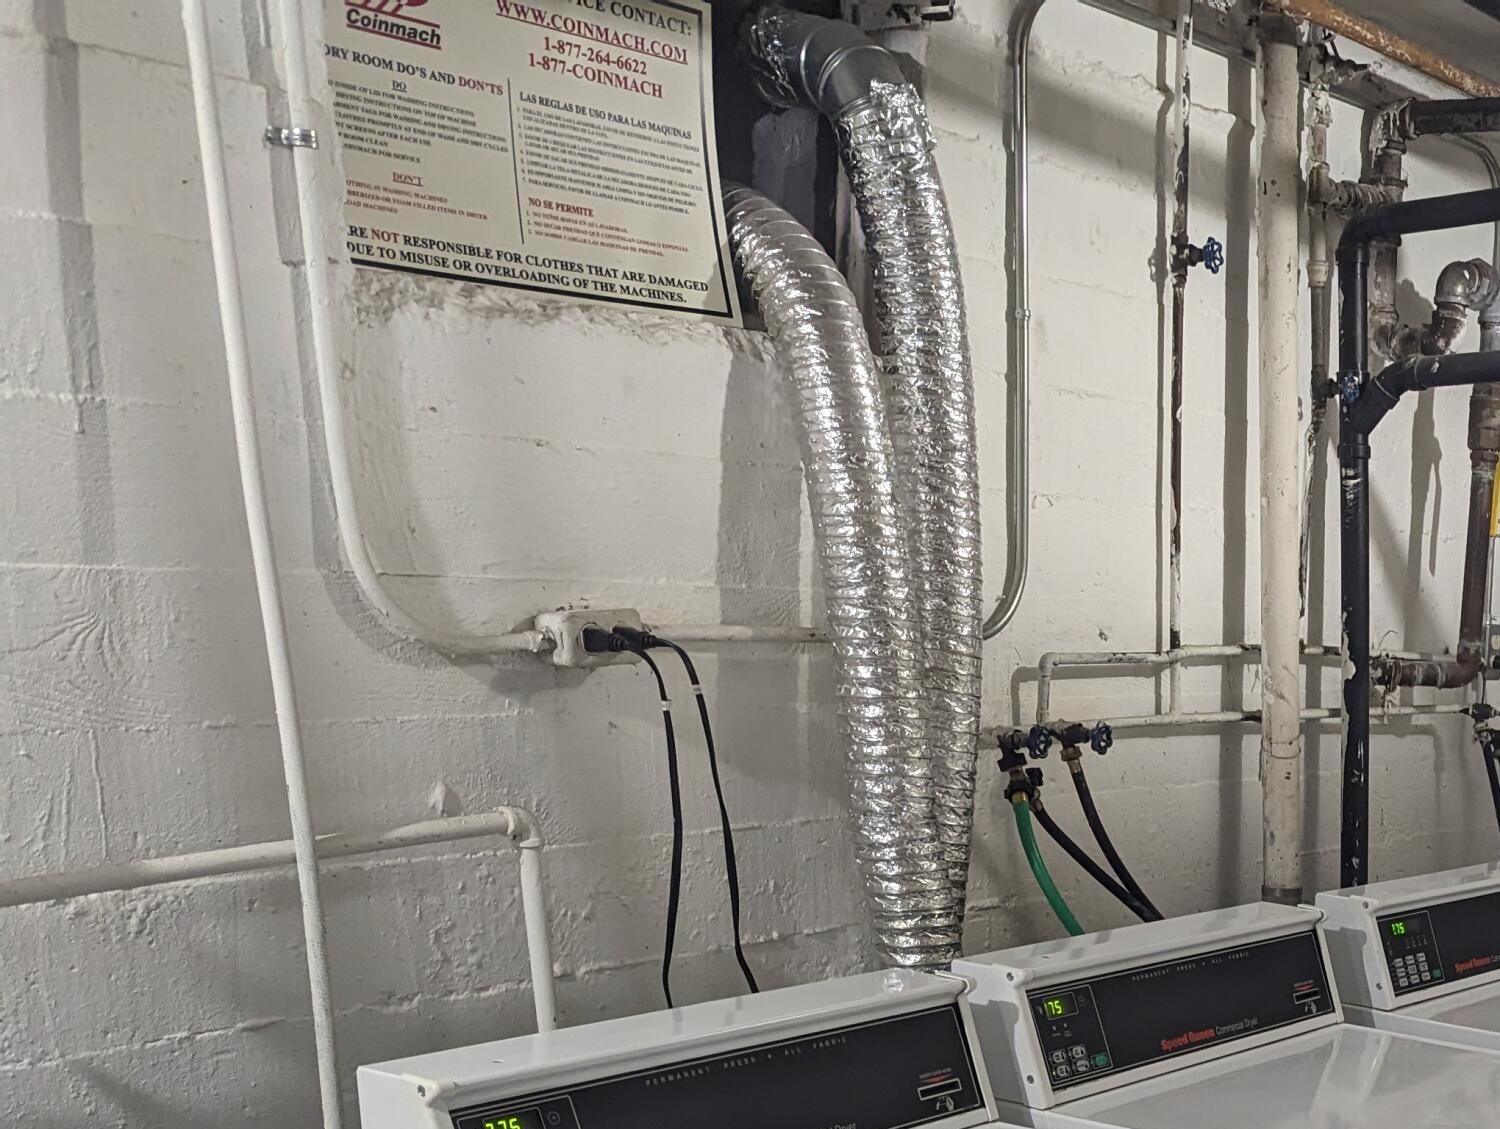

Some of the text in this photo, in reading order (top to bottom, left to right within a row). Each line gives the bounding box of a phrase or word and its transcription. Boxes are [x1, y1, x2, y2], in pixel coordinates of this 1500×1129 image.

[346, 8, 441, 45] Coinmach
[496, 0, 688, 64] WWW.COINMACH.COM
[568, 0, 692, 36] ICE CONTACT:
[352, 51, 393, 71] ROOM
[397, 61, 427, 79] DO'S
[429, 69, 455, 85] AND
[458, 76, 504, 96] DON'TS
[528, 52, 663, 98] 1-877-COINMACH
[543, 36, 647, 75] 1-877-264-6622
[392, 80, 407, 91] DO
[519, 91, 692, 140] LAS REGLAS DE USO PARA LAS MAQUINAS
[393, 172, 423, 186] DON'T
[528, 197, 594, 218] NO SE PERMITE
[371, 228, 400, 244] NOT
[403, 234, 493, 259] RESPONSIBLE
[496, 249, 522, 264] FOR
[525, 254, 584, 274] CLOTHES
[586, 264, 619, 279] THAT
[621, 270, 646, 283] ARE
[648, 273, 709, 292] DAMAGED
[376, 246, 396, 260] TO
[400, 250, 450, 269] MISUSE
[452, 259, 473, 272] OR
[475, 262, 570, 287] OVERLOADING
[573, 277, 589, 289] OF
[591, 280, 618, 294] THE
[619, 284, 687, 303] MACHINES.
